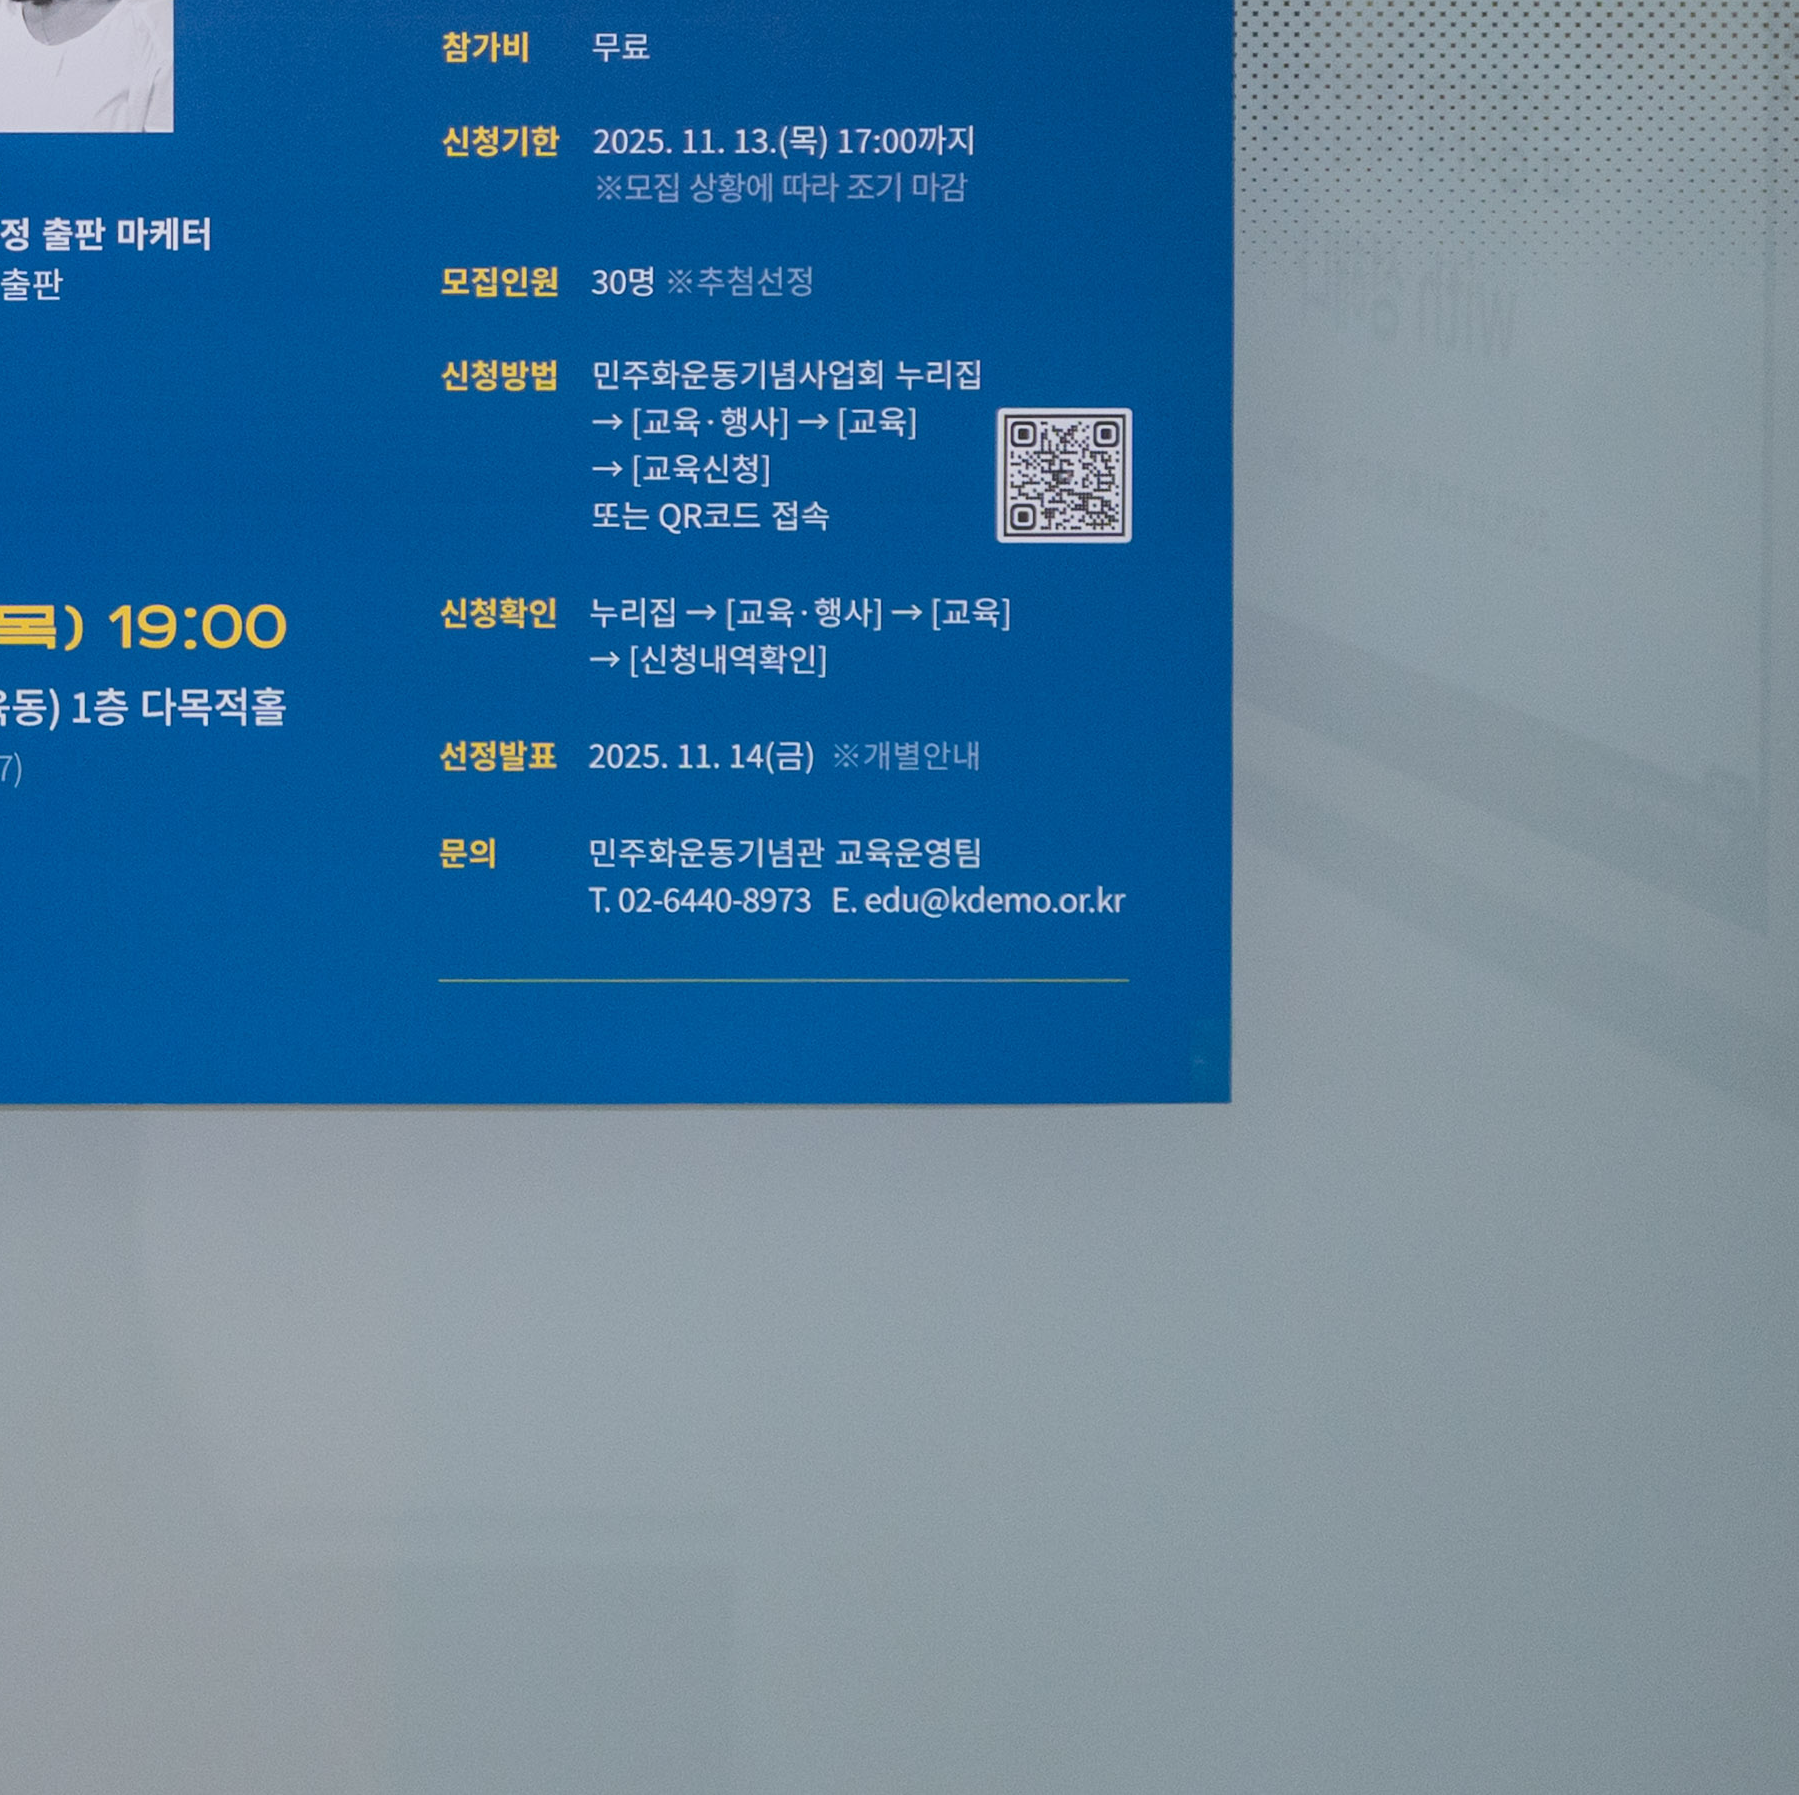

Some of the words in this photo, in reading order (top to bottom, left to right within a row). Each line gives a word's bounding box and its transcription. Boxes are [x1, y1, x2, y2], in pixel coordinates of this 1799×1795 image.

[442, 30, 529, 64] 참가비
[592, 32, 651, 63] 무료
[441, 124, 561, 158] 신청기한
[593, 127, 673, 155] 2025.
[682, 128, 725, 155] 11.
[734, 125, 828, 160] 13.(목)
[838, 124, 974, 156] 17:00까지
[689, 171, 774, 204] 상황에
[782, 171, 840, 204] 따라
[846, 171, 902, 203] 조기
[911, 171, 969, 203] 마감
[42, 216, 107, 252] 출판
[117, 216, 211, 252] 마케터
[440, 265, 559, 298] 모집인원
[591, 265, 654, 298] 30명
[441, 359, 558, 392] 신청방법
[593, 359, 884, 391] 민주화운동기념사업회
[895, 359, 981, 391] 누리집
[837, 406, 917, 441] [교육]
[632, 453, 770, 488] [교육신청]
[592, 501, 650, 531] 또는
[658, 502, 761, 535] QR코드
[772, 500, 830, 532] 접속
[108, 603, 288, 650] 19:00
[440, 596, 557, 630] 신청확인
[590, 597, 676, 629] 누리집
[931, 597, 1011, 632] [교육]
[630, 643, 827, 679] [신청내역확인]
[72, 687, 129, 727] 1층
[141, 686, 287, 727] 다목적홀
[439, 739, 558, 772] 선정발표
[588, 742, 668, 770] 2025.
[678, 743, 720, 769] 11.
[730, 740, 814, 775] 14(금)
[439, 837, 496, 869] 문의
[589, 837, 825, 869] 민주화운동기념관
[835, 837, 981, 869] 교육운영팀
[588, 886, 611, 914] T.
[617, 886, 812, 914] 02-6440-8973
[832, 886, 857, 914] E.
[863, 885, 1127, 919] edu@kdemo.or.kr
